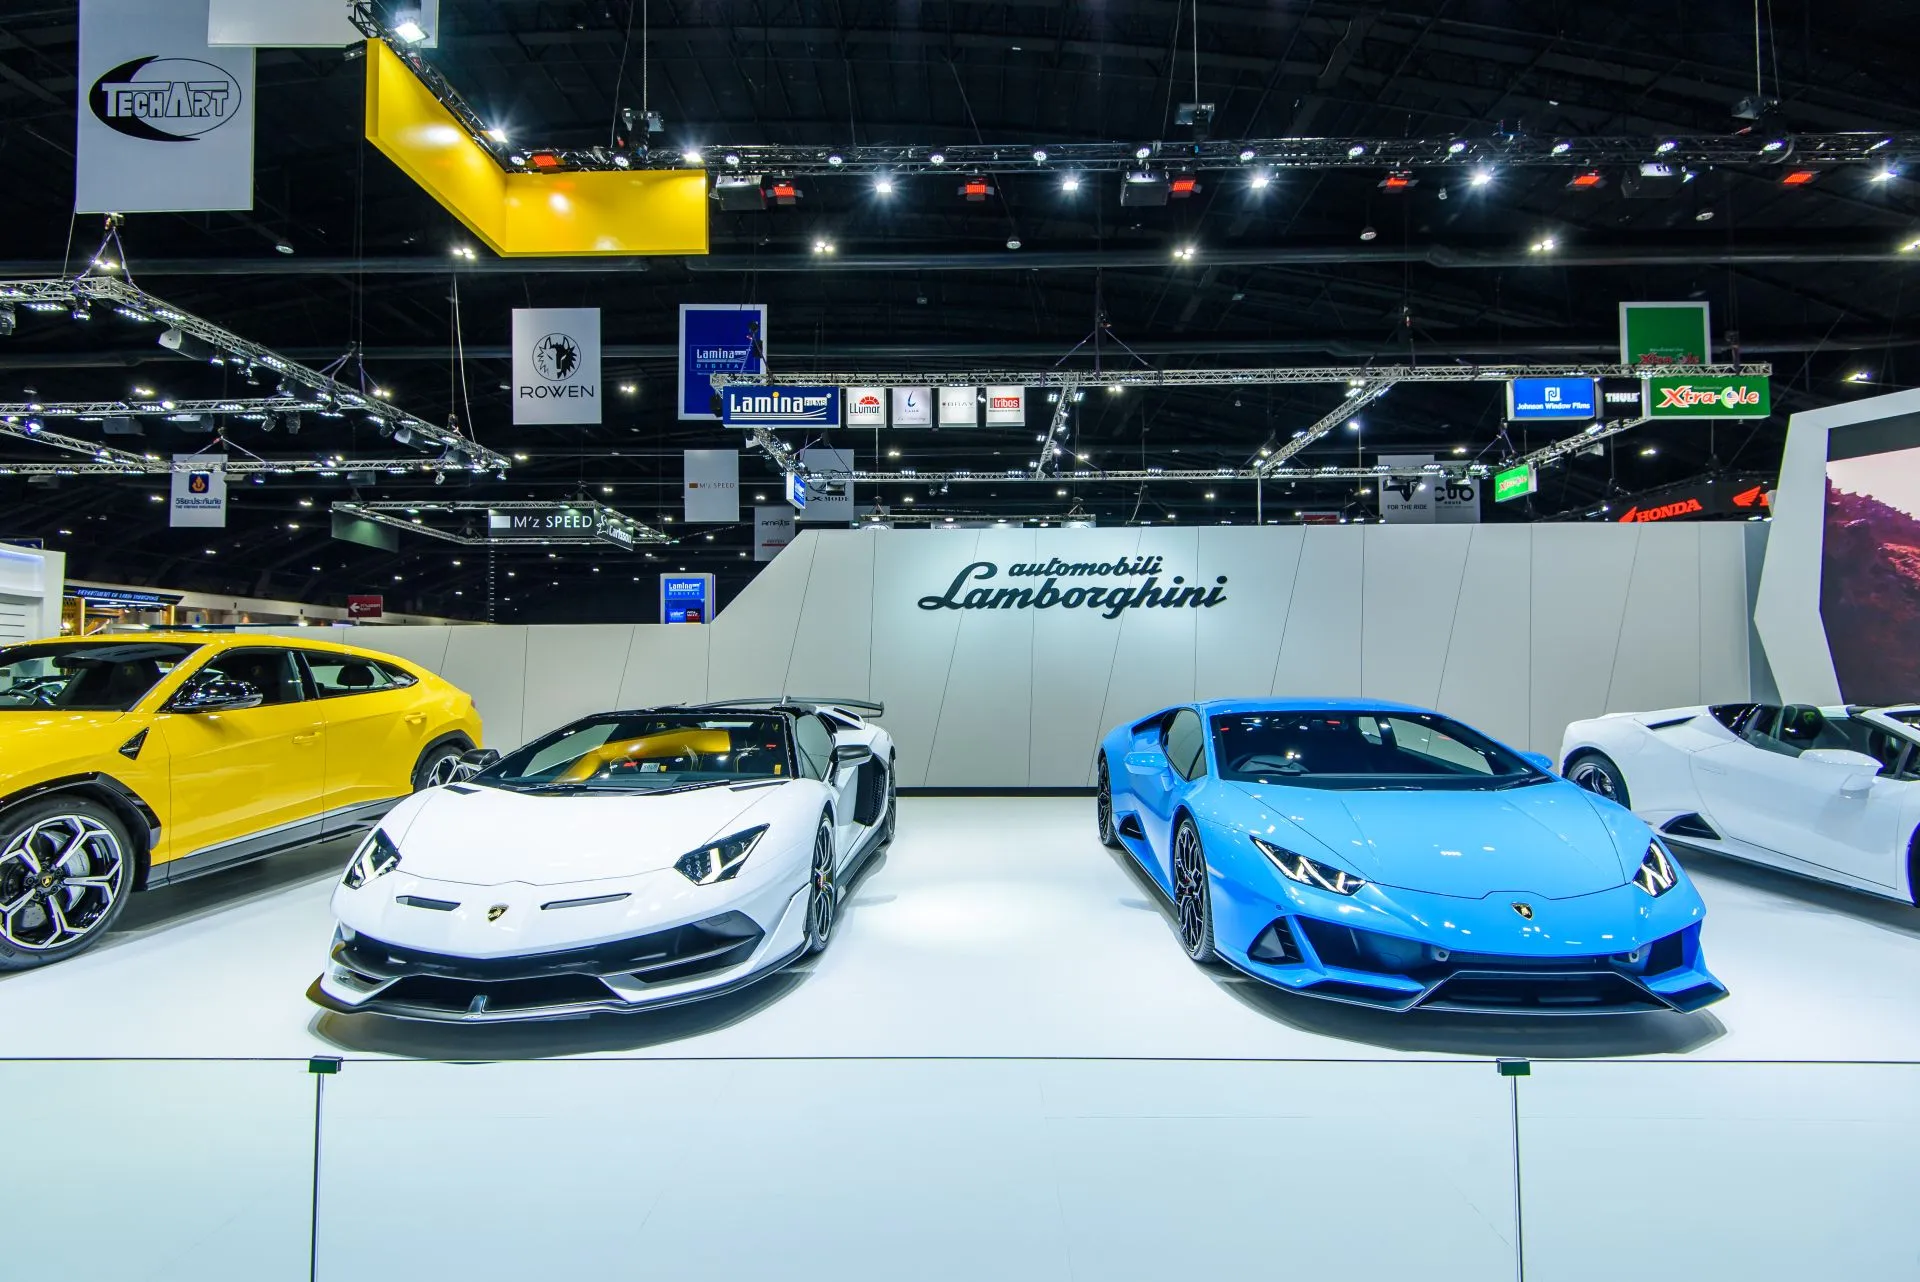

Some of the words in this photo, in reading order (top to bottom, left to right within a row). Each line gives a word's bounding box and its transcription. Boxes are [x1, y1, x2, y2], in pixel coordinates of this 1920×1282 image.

[696, 348, 735, 359] Lamina
[520, 385, 595, 399] ROWEN
[1605, 392, 1639, 402] THULE
[731, 391, 804, 413] Lamina
[994, 397, 1019, 408] tribos
[1545, 402, 1571, 410] Window
[1636, 498, 1703, 523] HONDA
[514, 516, 540, 528] M'z
[546, 515, 593, 528] SPEED
[1008, 555, 1164, 577] automobili
[917, 561, 1228, 619] Lamborghini
